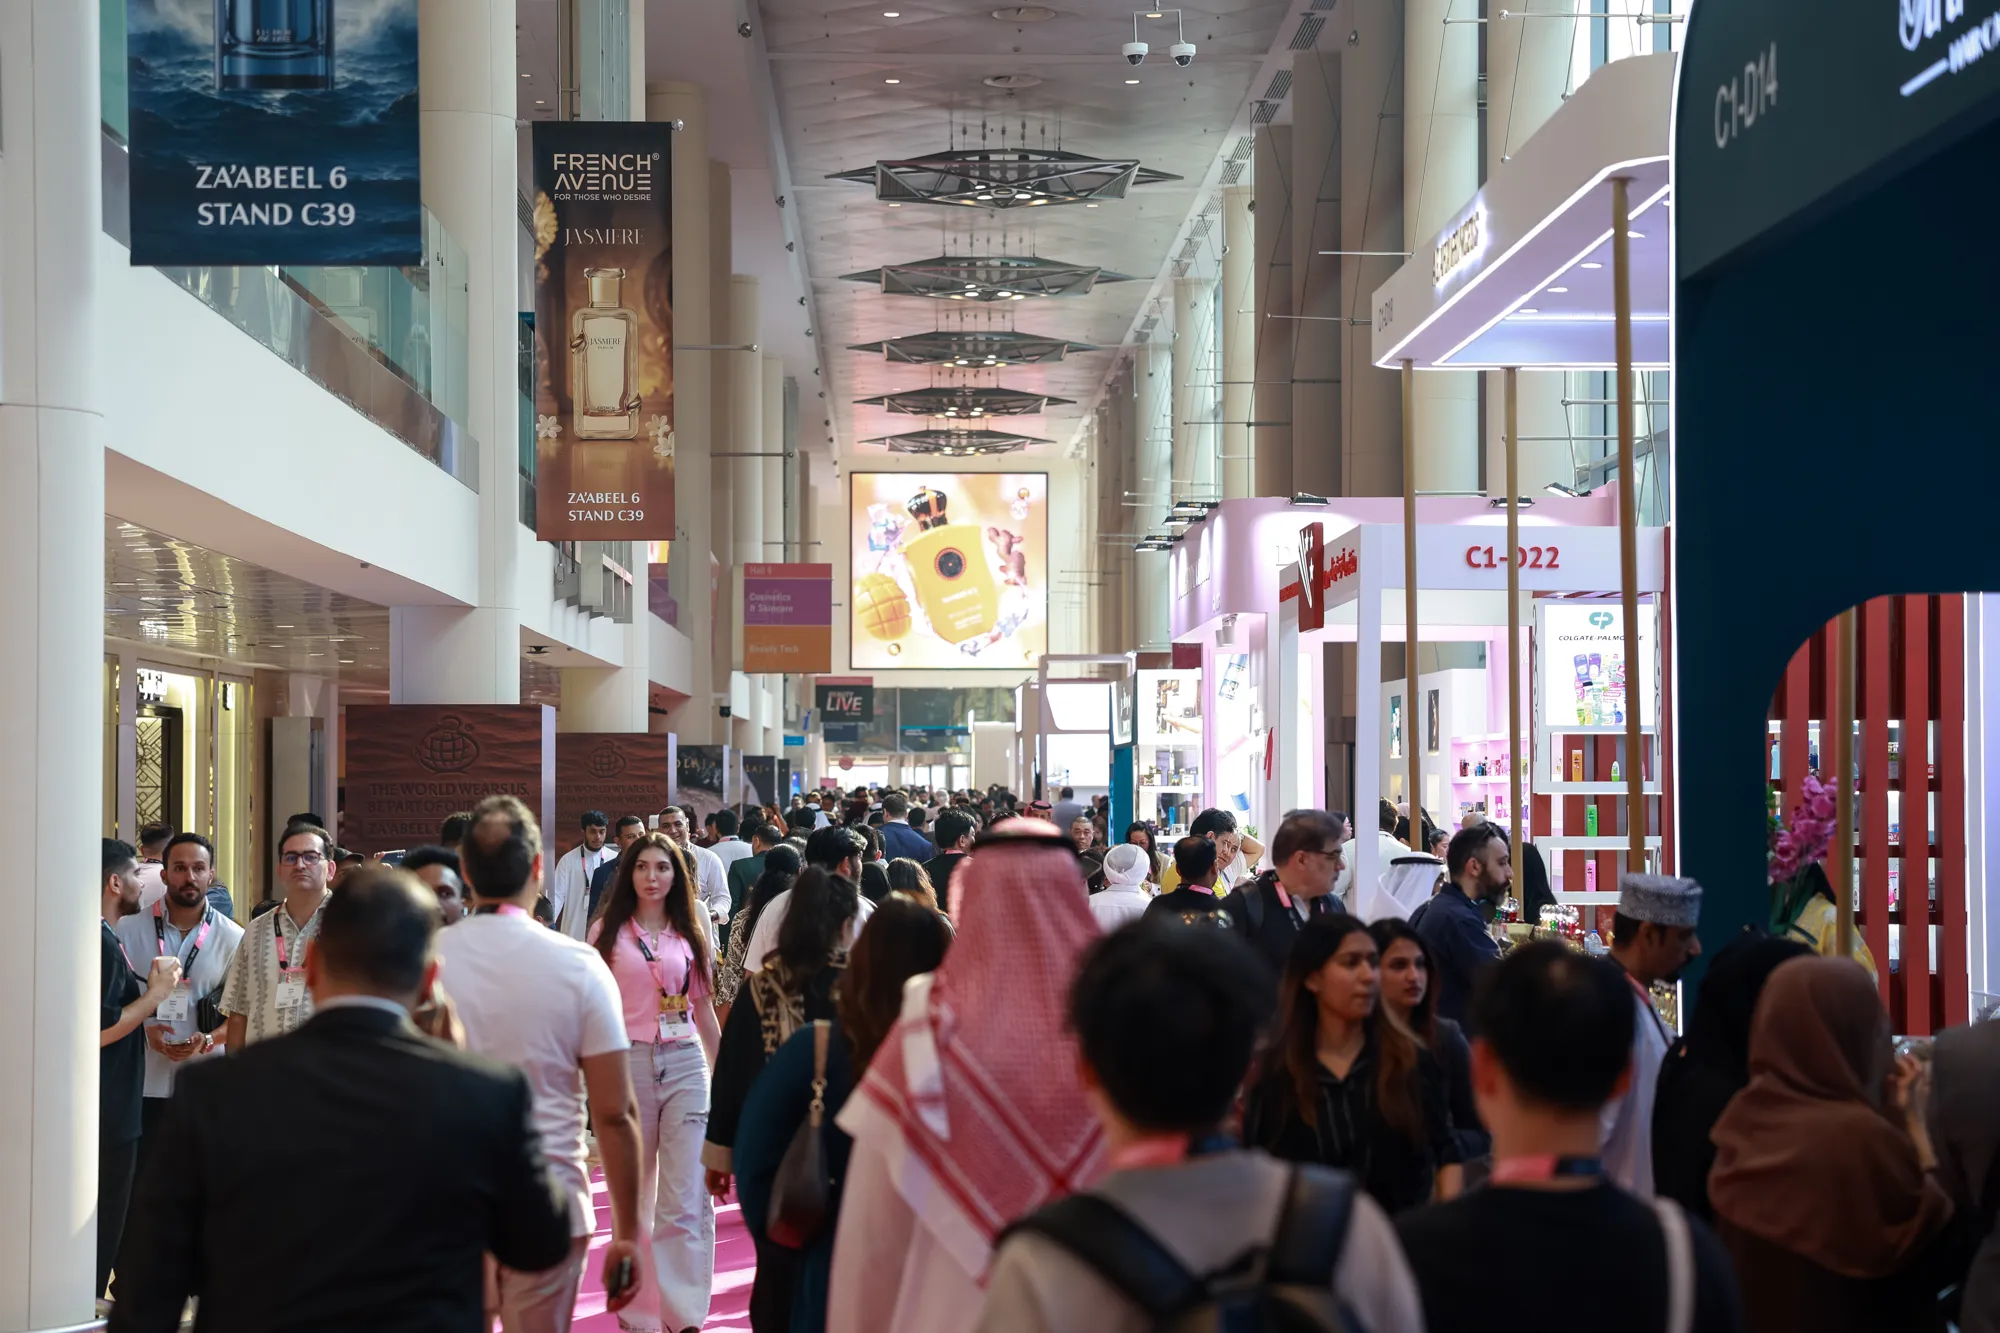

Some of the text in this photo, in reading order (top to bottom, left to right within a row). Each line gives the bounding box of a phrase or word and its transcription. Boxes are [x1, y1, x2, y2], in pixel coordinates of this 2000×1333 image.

[1714, 41, 1778, 149] C1-D14
[329, 165, 348, 189] 6
[554, 173, 651, 191] AVENUE
[554, 193, 651, 201] FOR THOSE WHO DESIRE
[197, 202, 356, 226] STAND C39
[564, 228, 645, 246] JASMERE
[631, 492, 640, 504] 6
[568, 509, 644, 521] STAND C39
[749, 565, 765, 575] Hall
[749, 593, 791, 601] Cosmetics
[758, 604, 794, 613] Skincare
[749, 645, 799, 655] Beauty Tech
[826, 696, 863, 711] LIVE
[369, 782, 399, 796] THE
[400, 782, 455, 796] WORLD
[457, 782, 508, 796] WEARS
[573, 785, 611, 794] WORLD
[612, 785, 644, 794] WEARS
[387, 800, 421, 813] PART
[424, 800, 445, 813] OF
[445, 800, 475, 813] OUR
